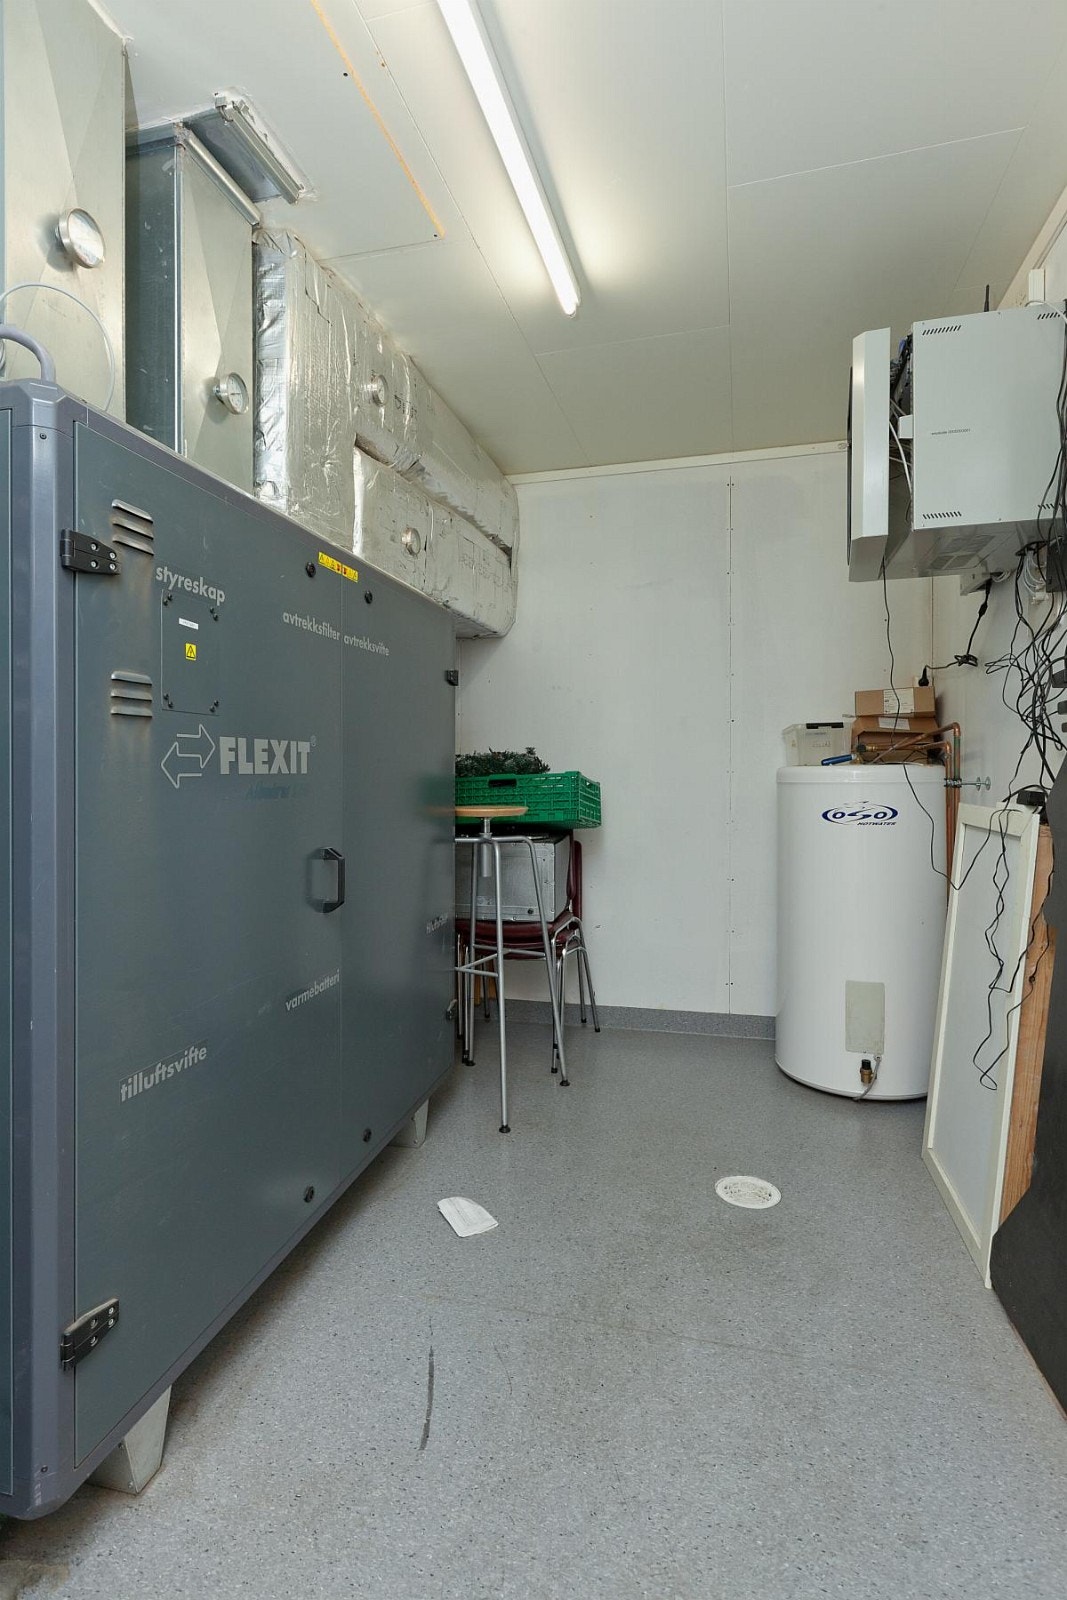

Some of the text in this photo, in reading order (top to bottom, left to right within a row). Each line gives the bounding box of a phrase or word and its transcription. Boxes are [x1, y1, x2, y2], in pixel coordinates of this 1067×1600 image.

[155, 565, 226, 606] styreskap
[282, 610, 341, 643] avtrekksfilter
[219, 736, 312, 775] FLEXIT
[286, 969, 340, 1011] varmebatteri
[120, 1043, 208, 1102] tilluftsvifte
